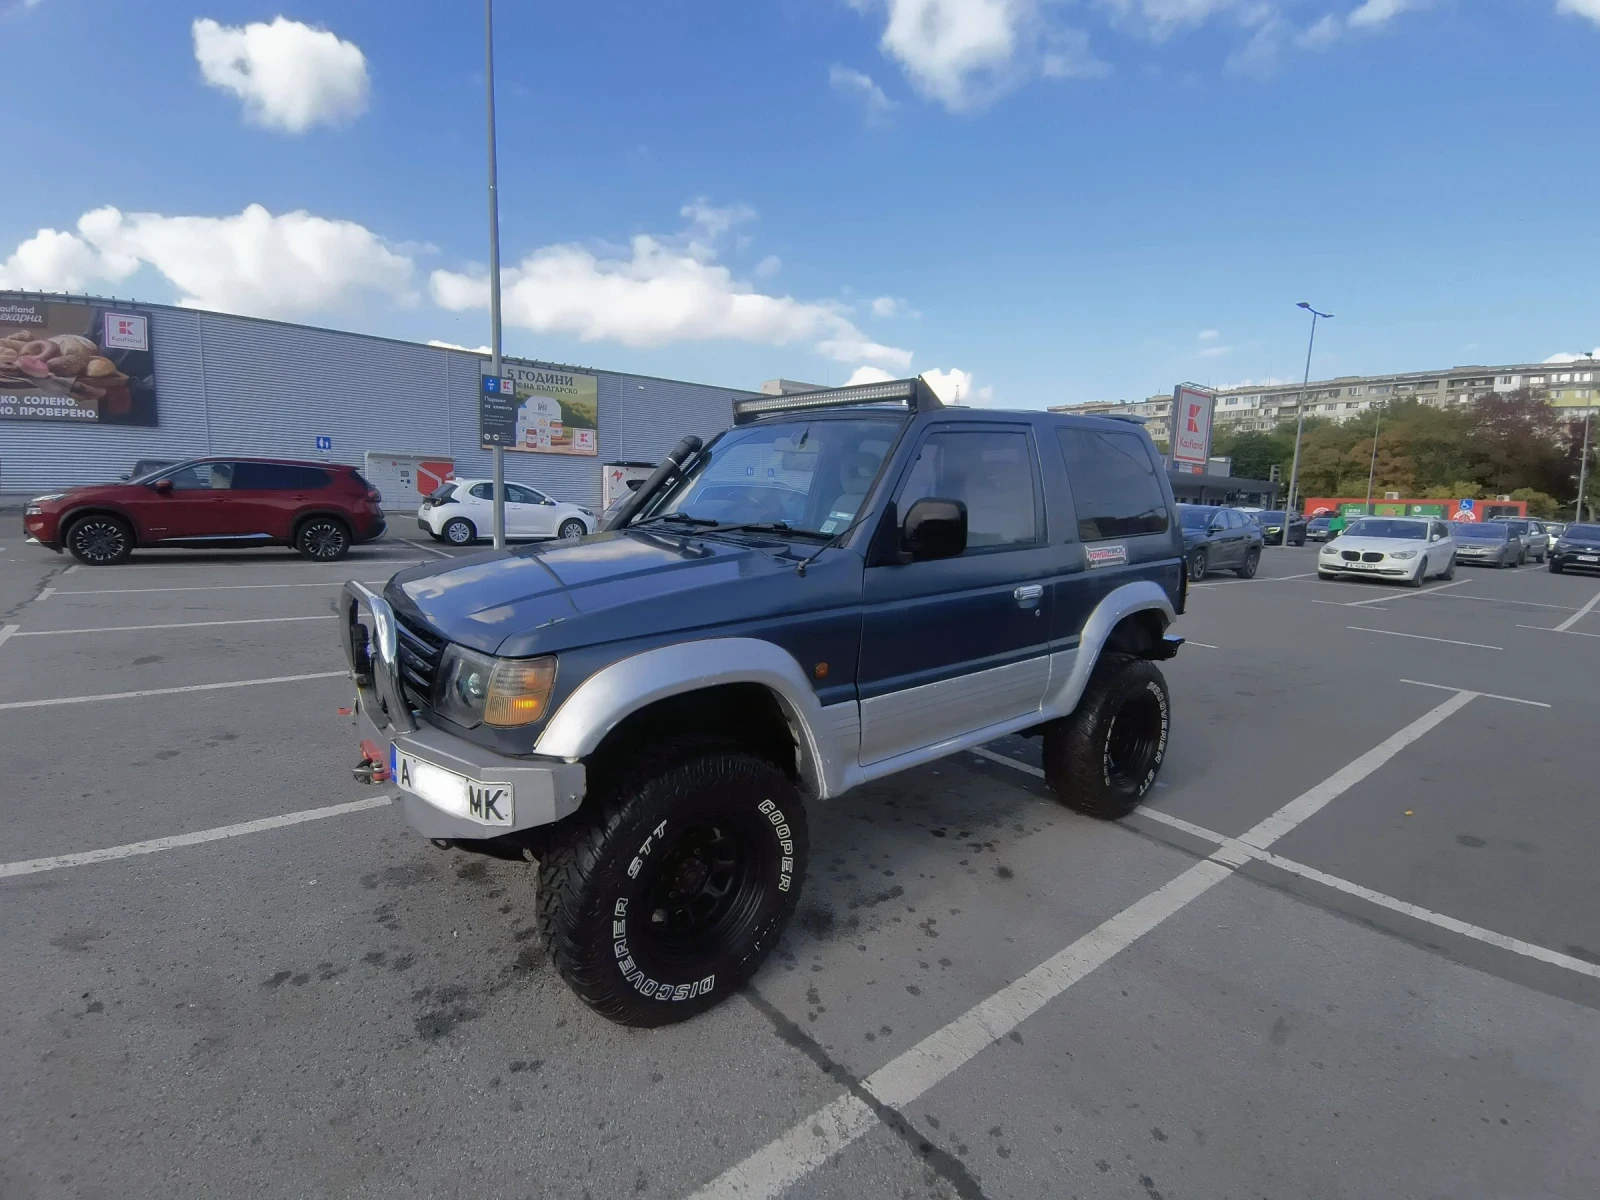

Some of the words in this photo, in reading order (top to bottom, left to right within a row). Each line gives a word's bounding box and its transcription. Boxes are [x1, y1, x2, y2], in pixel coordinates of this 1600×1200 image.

[0, 305, 35, 314] aufland
[0, 313, 44, 324] екарна
[111, 335, 142, 344] Kaufland
[507, 369, 514, 379] 5
[518, 370, 574, 387] ГОДИНИ
[536, 384, 579, 395] БЪЛГАРСКО
[23, 396, 79, 407] СОЛЕНО.
[19, 406, 99, 418] ПРОВЕРЕНО.
[1180, 437, 1204, 451] Kaufland
[1146, 681, 1168, 764] DISCOVERER
[401, 758, 412, 788] A
[469, 785, 505, 821] MK
[1138, 768, 1155, 796] STT
[627, 818, 669, 880] STT
[758, 798, 794, 893] COOPER
[612, 896, 716, 1002] DISCOVERER
